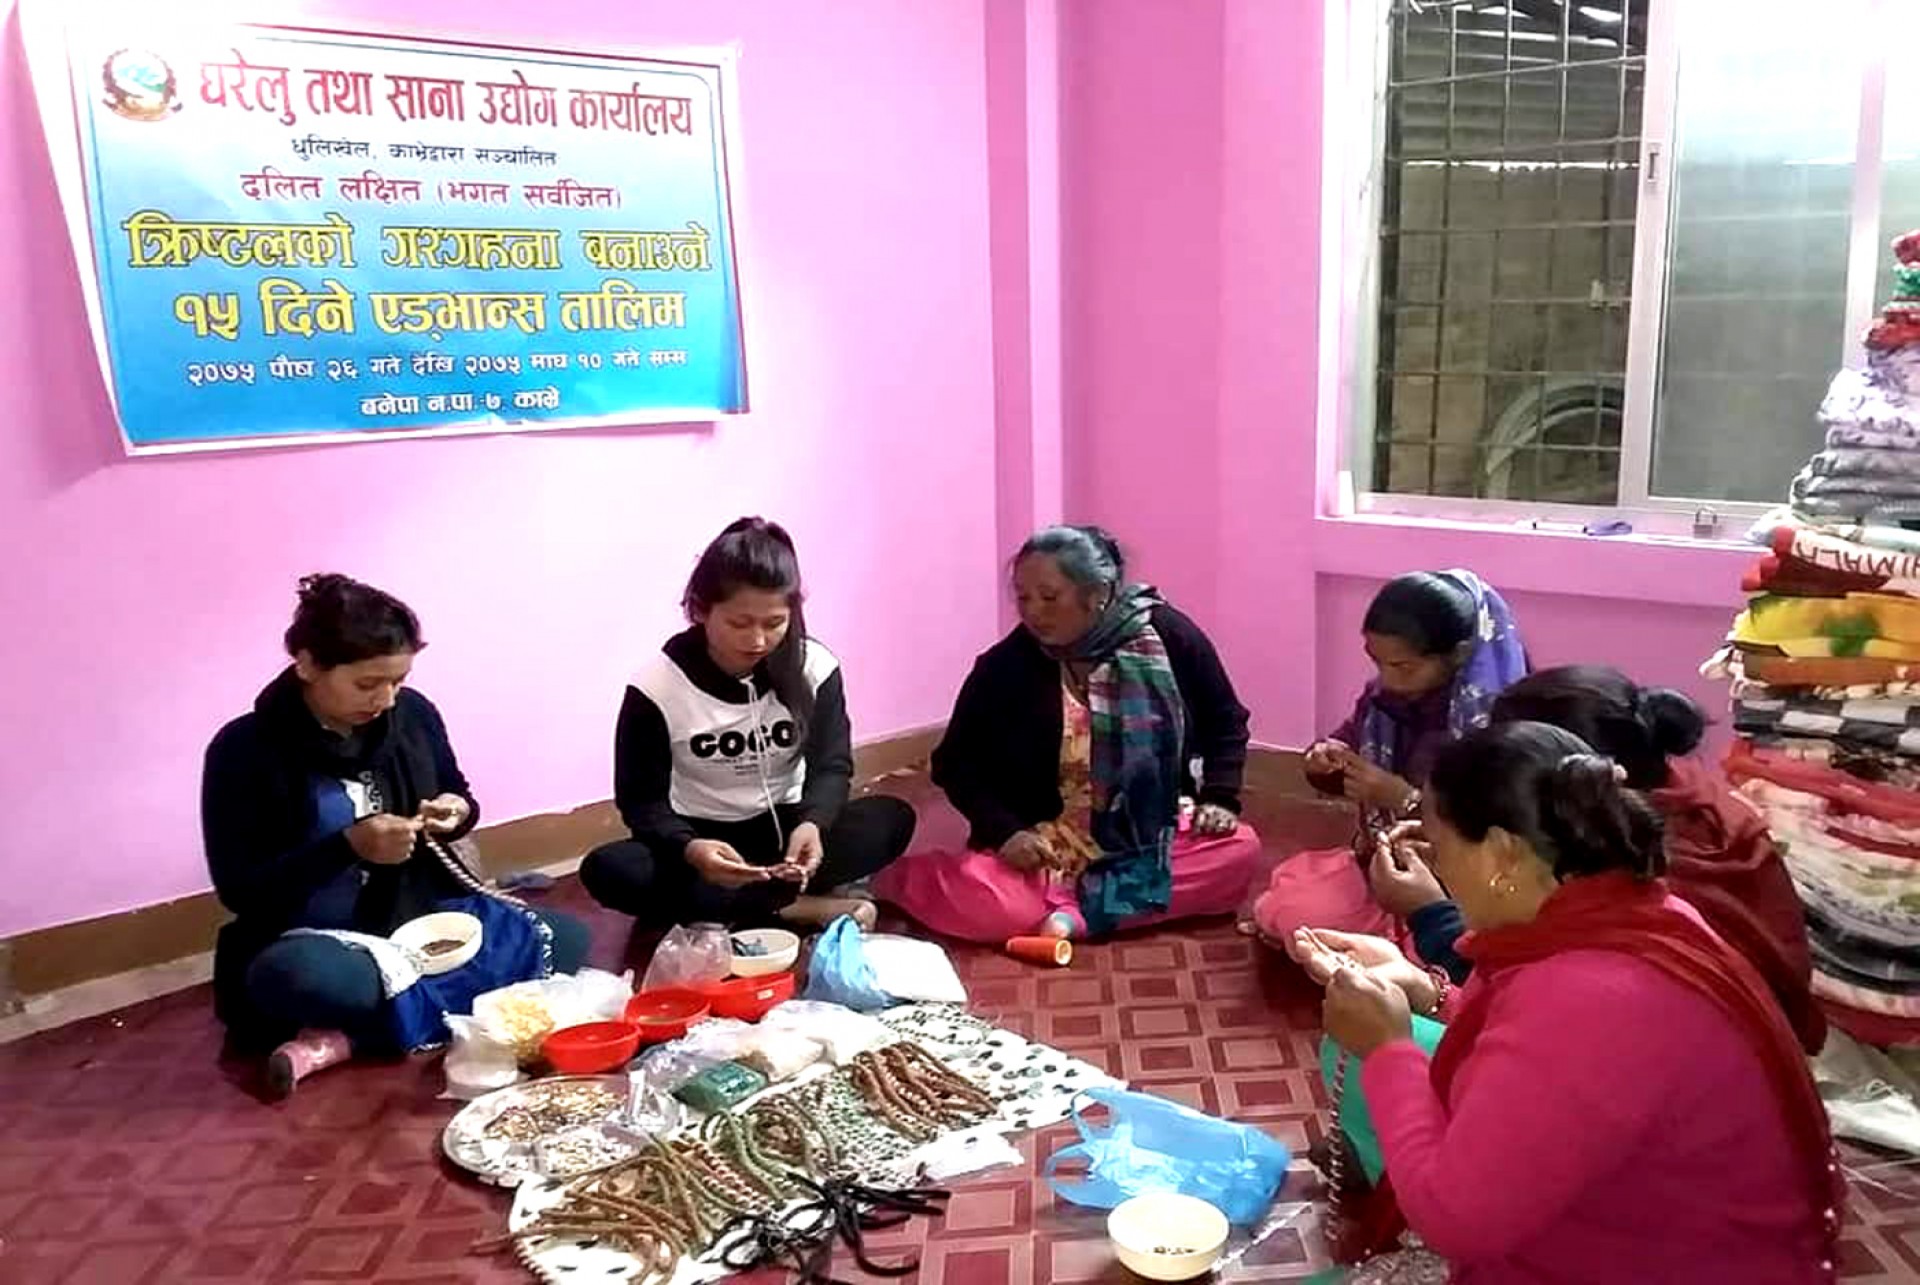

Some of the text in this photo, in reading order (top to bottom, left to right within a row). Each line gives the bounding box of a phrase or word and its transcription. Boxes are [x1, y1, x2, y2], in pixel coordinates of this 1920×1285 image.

[200, 48, 692, 136] घरेलु तथा साना उद्योग कार्यालय
[240, 165, 324, 199] दलित
[337, 169, 423, 203] लक्षित
[578, 221, 713, 270] बनाउने
[173, 292, 241, 341] १५
[258, 276, 355, 338] दिने
[557, 278, 687, 333] तालिम
[187, 361, 256, 385] २०७५
[327, 359, 359, 382] २६
[369, 353, 401, 375] गते
[464, 355, 521, 378] २०७५
[577, 351, 601, 370] १०
[360, 392, 419, 416] बनेपा
